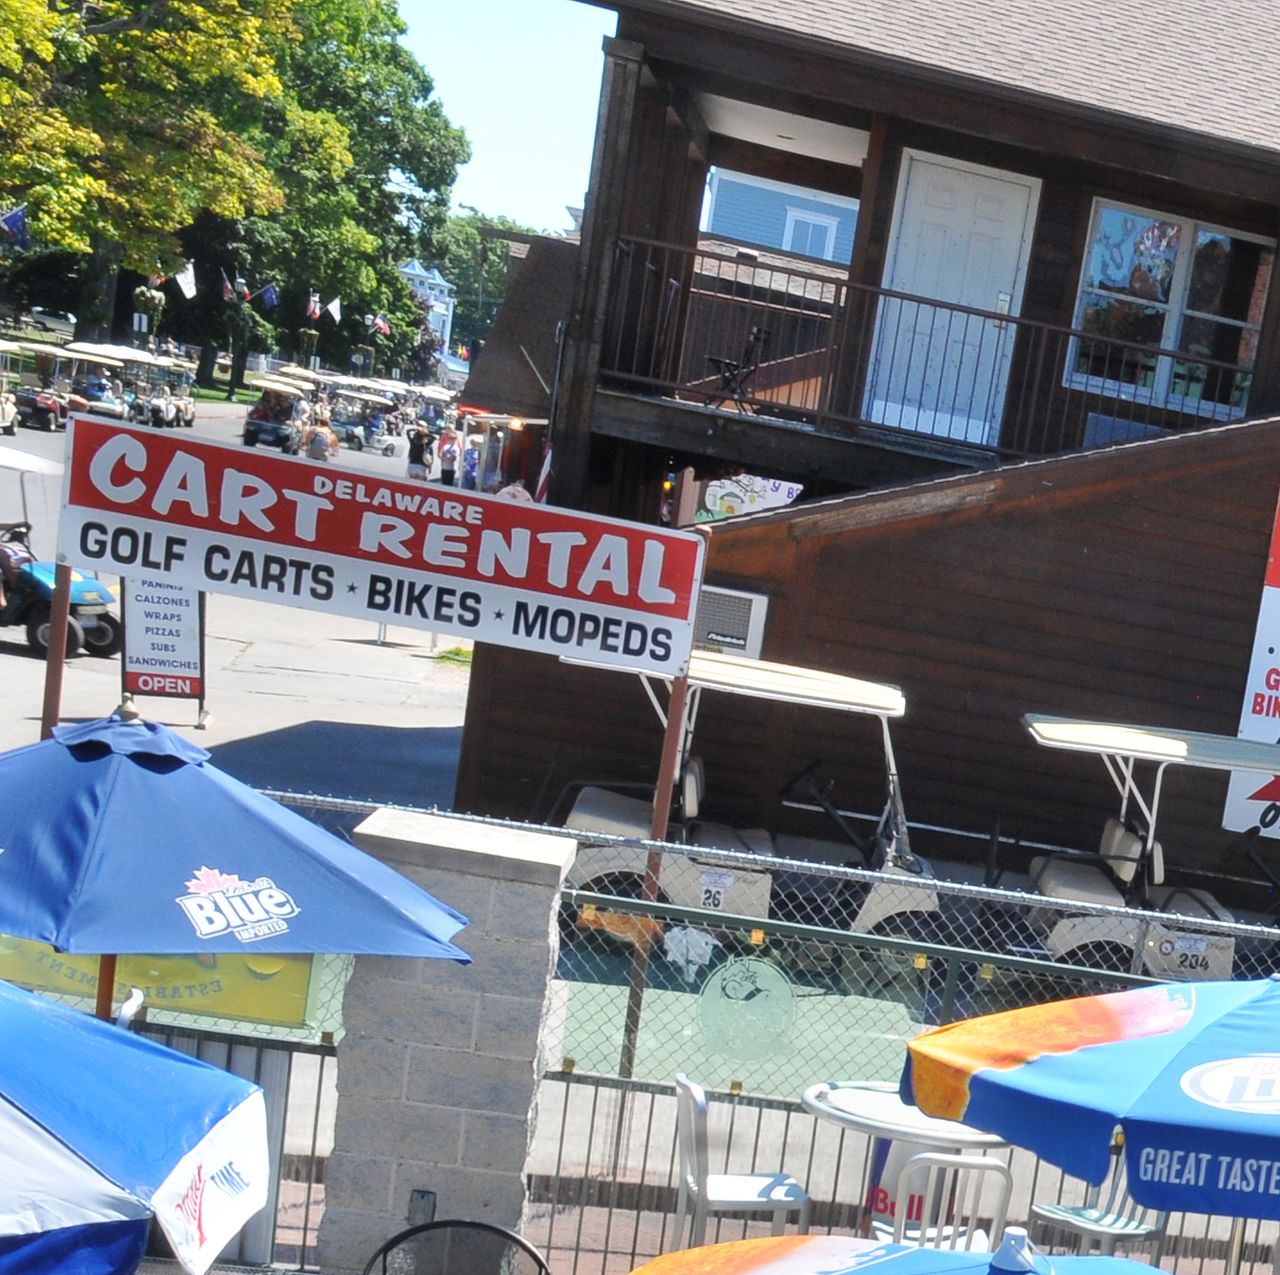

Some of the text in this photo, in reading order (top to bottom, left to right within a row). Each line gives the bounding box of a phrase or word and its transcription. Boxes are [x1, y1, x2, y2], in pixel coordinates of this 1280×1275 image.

[313, 474, 484, 525] DELAWARE
[89, 433, 677, 604] CART RENTAL
[79, 520, 674, 662] GOLF CARTS BIKES MOPEDS
[134, 593, 191, 608] CALZONES
[143, 610, 183, 622] WRAPS
[144, 626, 181, 638] PIZZAS
[150, 642, 177, 653] SUBS
[128, 655, 199, 670] SANDWICHES
[137, 675, 191, 694] OPEN
[702, 888, 721, 908] 26
[178, 887, 294, 936] Blue
[238, 919, 288, 941] IMPORTED
[1139, 1147, 1212, 1187] GREAT
